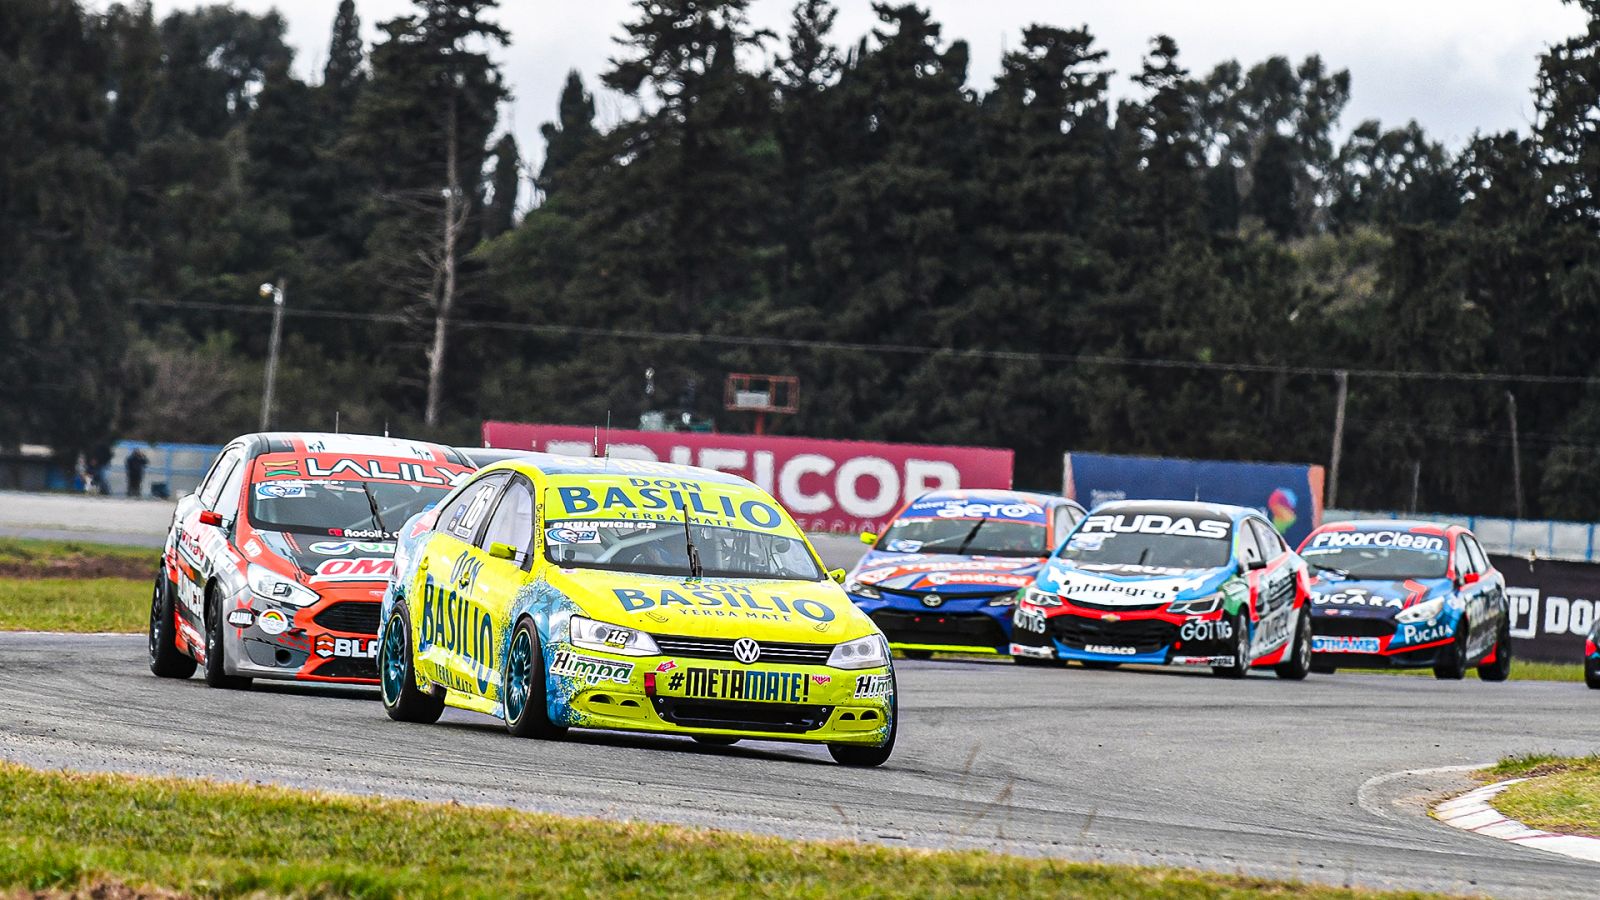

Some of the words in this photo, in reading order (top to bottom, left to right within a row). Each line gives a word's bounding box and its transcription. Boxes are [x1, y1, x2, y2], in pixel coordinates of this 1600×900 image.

[305, 457, 476, 487] LALILY
[545, 440, 960, 518] ICOR
[628, 478, 702, 492] DON
[461, 485, 494, 529] 16
[558, 487, 782, 528] BASILIO
[619, 512, 678, 522] YERBA
[687, 517, 734, 527] MATE
[1082, 515, 1230, 538] RUDAS
[1312, 531, 1443, 551] FloorClean
[680, 582, 749, 594] DON
[612, 588, 836, 622] BASILIO
[678, 609, 738, 618] YERBA
[745, 612, 791, 622] MATE
[419, 573, 494, 694] BASILIO
[609, 631, 629, 644] 16
[552, 652, 632, 684] Himpa
[668, 668, 809, 702] #METAMATE!
